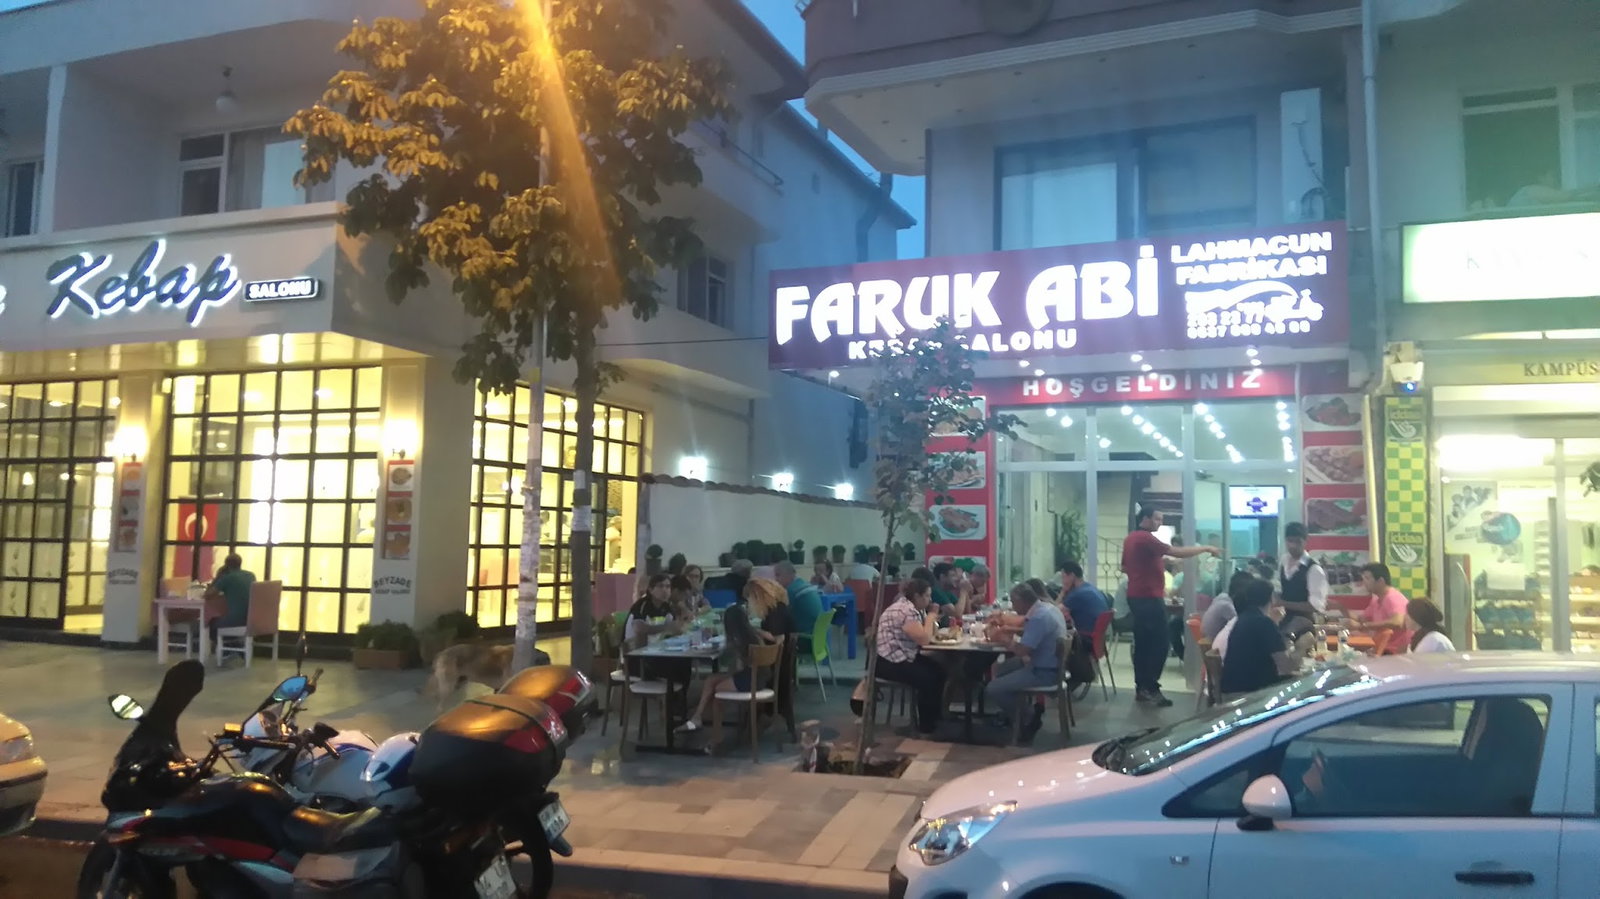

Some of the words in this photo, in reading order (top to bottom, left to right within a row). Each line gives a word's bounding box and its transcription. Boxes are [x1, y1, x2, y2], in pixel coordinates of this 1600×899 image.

[1171, 231, 1332, 263] LAHMACUN
[46, 238, 242, 327] Kebap
[247, 279, 313, 299] SALONU
[775, 270, 1002, 345] FARUK
[1025, 244, 1159, 330] ABİ
[1022, 369, 1263, 398] HOŞGELDİNİZ
